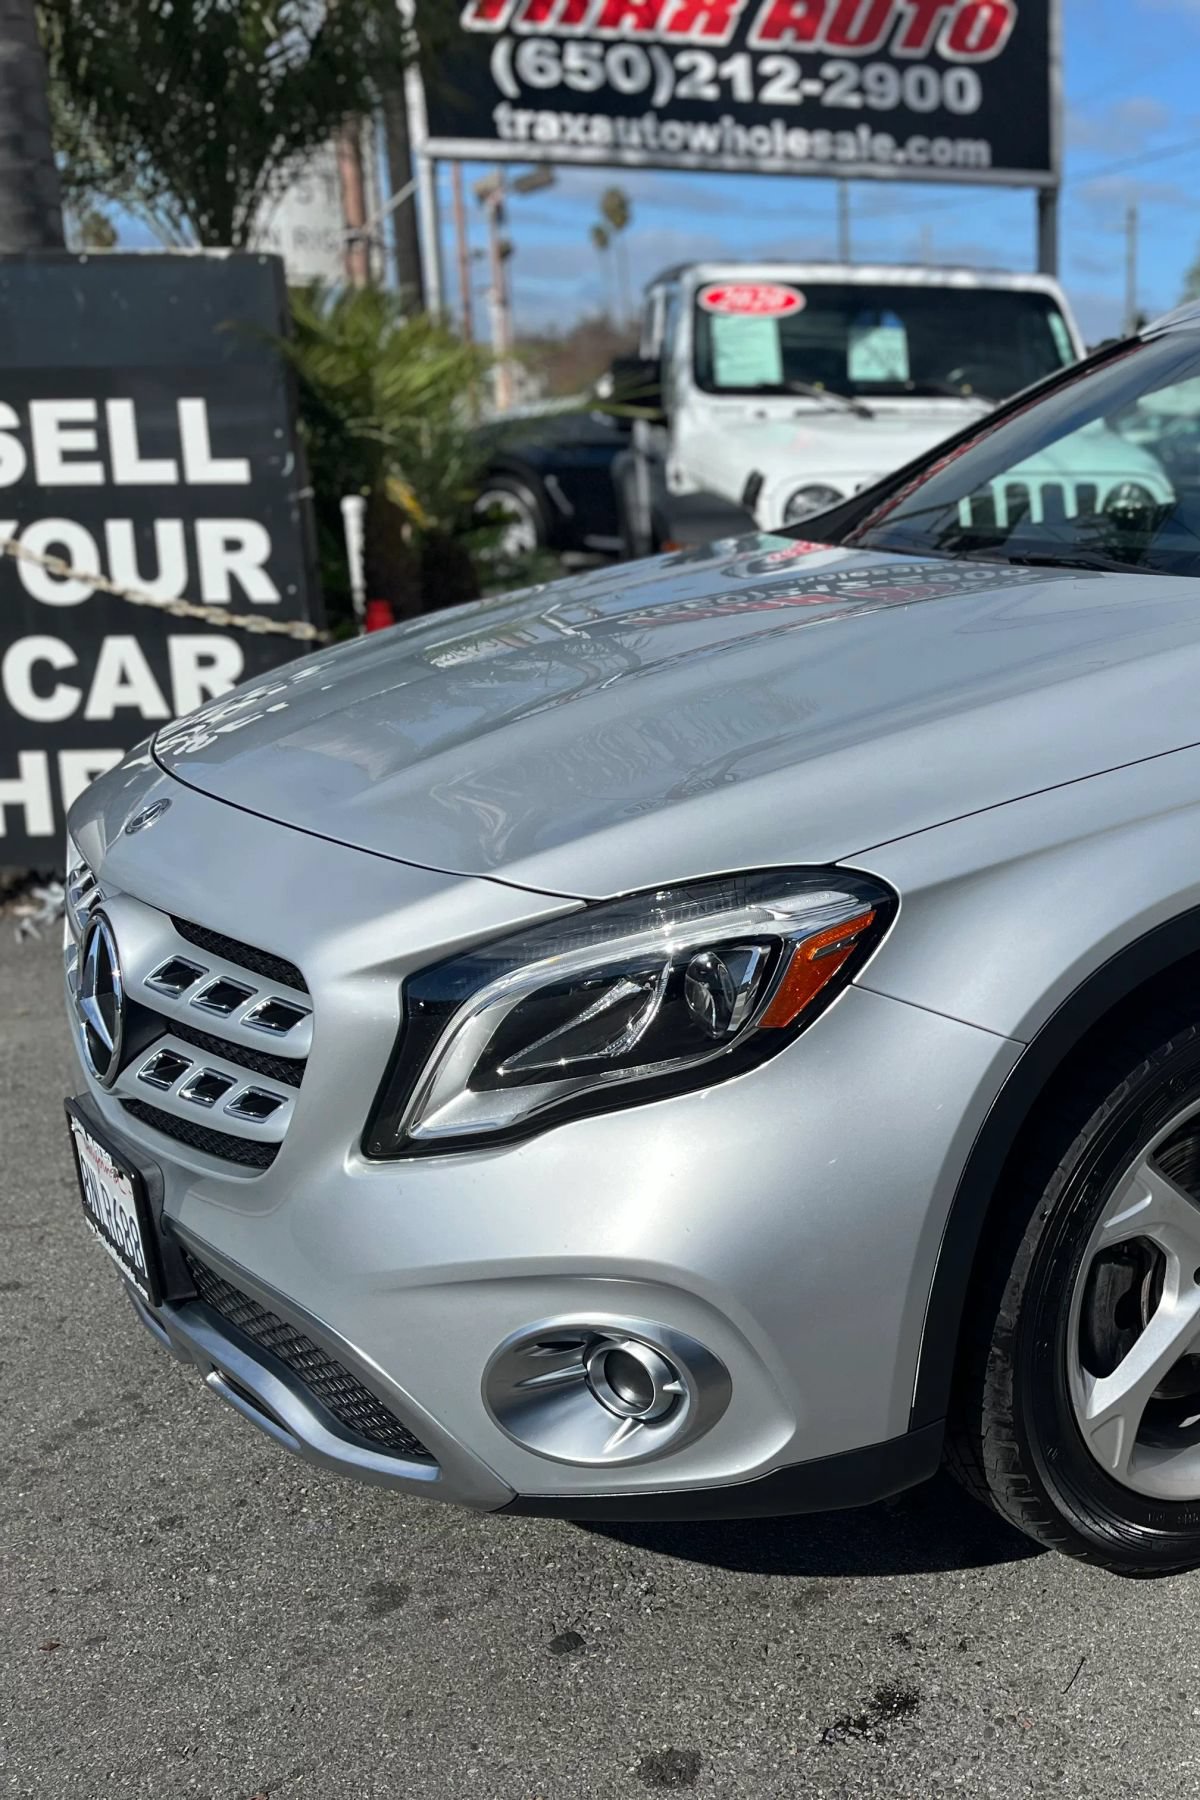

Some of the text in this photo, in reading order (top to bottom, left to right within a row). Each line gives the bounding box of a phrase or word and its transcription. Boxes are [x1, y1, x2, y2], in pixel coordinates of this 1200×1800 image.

[746, 0, 1018, 63] AUTO
[490, 37, 982, 115] (650)212-2900
[493, 100, 992, 168] traxautowholesale.com
[0, 517, 281, 606] OUR
[2, 634, 245, 722] CAR
